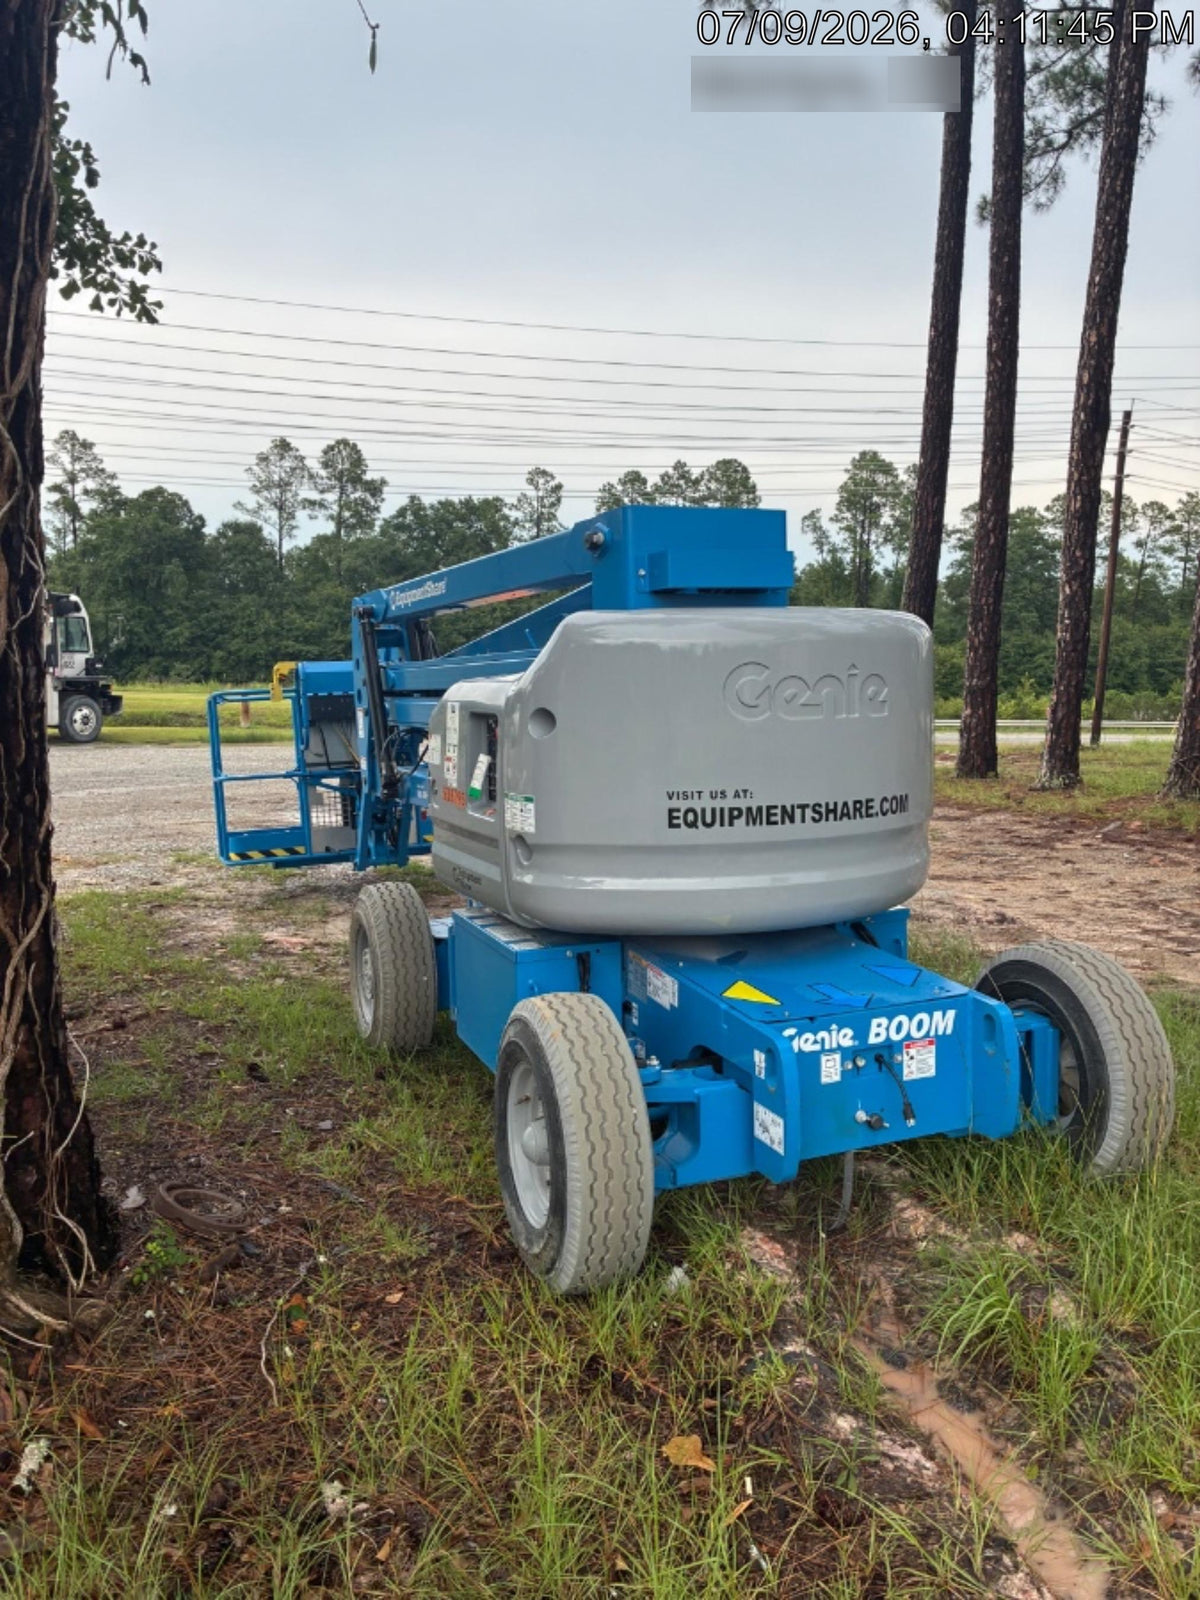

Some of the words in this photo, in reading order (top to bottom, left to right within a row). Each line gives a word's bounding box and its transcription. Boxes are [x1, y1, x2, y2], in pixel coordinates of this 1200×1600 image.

[722, 660, 889, 722] Genie
[666, 790, 704, 802] VISIT
[709, 789, 728, 800] US
[733, 788, 754, 800] AT:
[666, 793, 910, 830] EQUIPMENTSHARE.COM
[867, 1009, 957, 1044] BOOM
